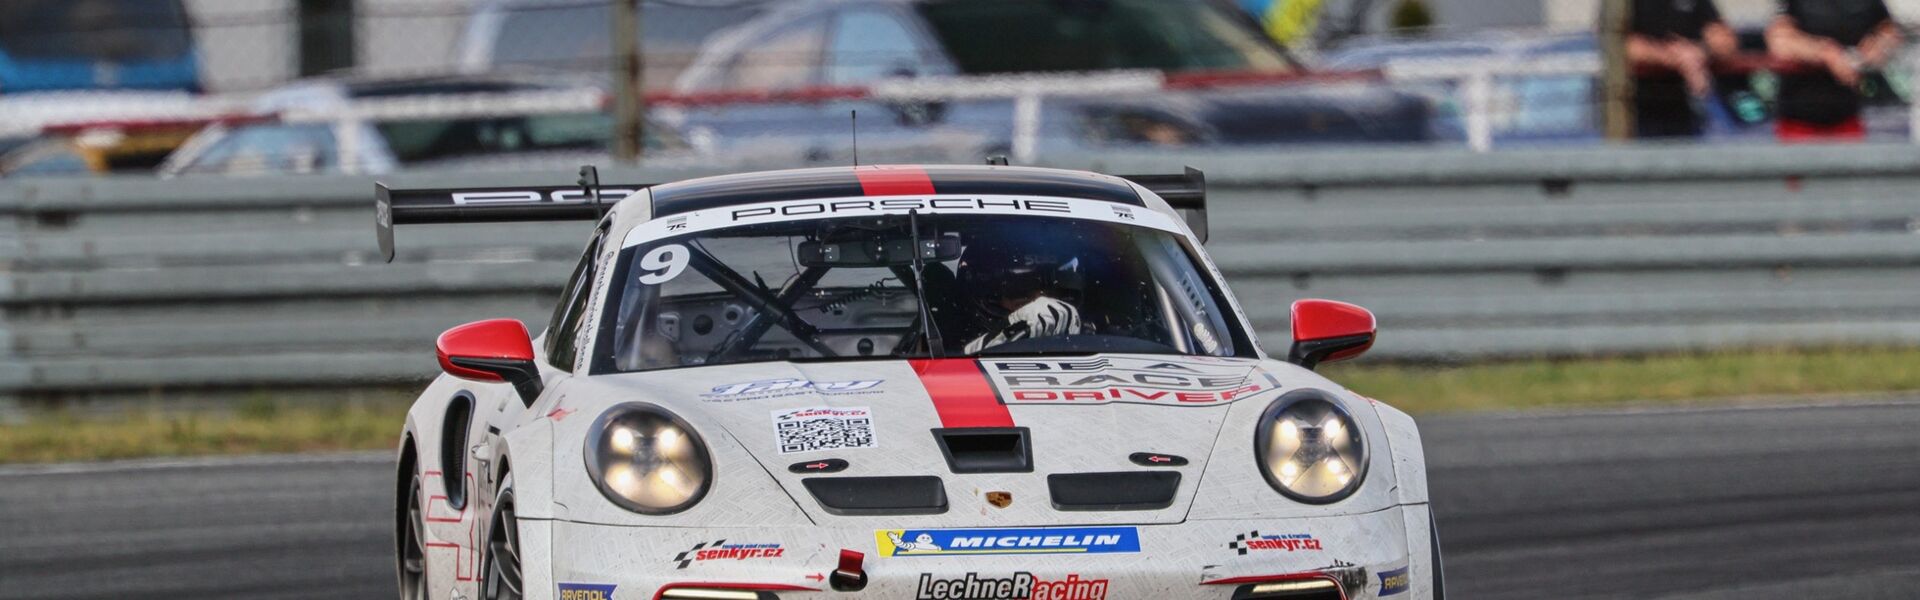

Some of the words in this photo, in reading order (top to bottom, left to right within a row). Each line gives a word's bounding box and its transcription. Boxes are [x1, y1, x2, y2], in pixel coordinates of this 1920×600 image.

[732, 198, 1071, 221] PORSCHE
[639, 244, 690, 285] 9
[994, 359, 1113, 372] BE
[1144, 362, 1200, 373] A
[1003, 374, 1253, 388] RACE
[1014, 385, 1262, 403] DRIVER
[950, 535, 1121, 548] MICHELIN
[1246, 539, 1323, 552] senkyr.cz
[695, 546, 784, 561] senkyr.cz
